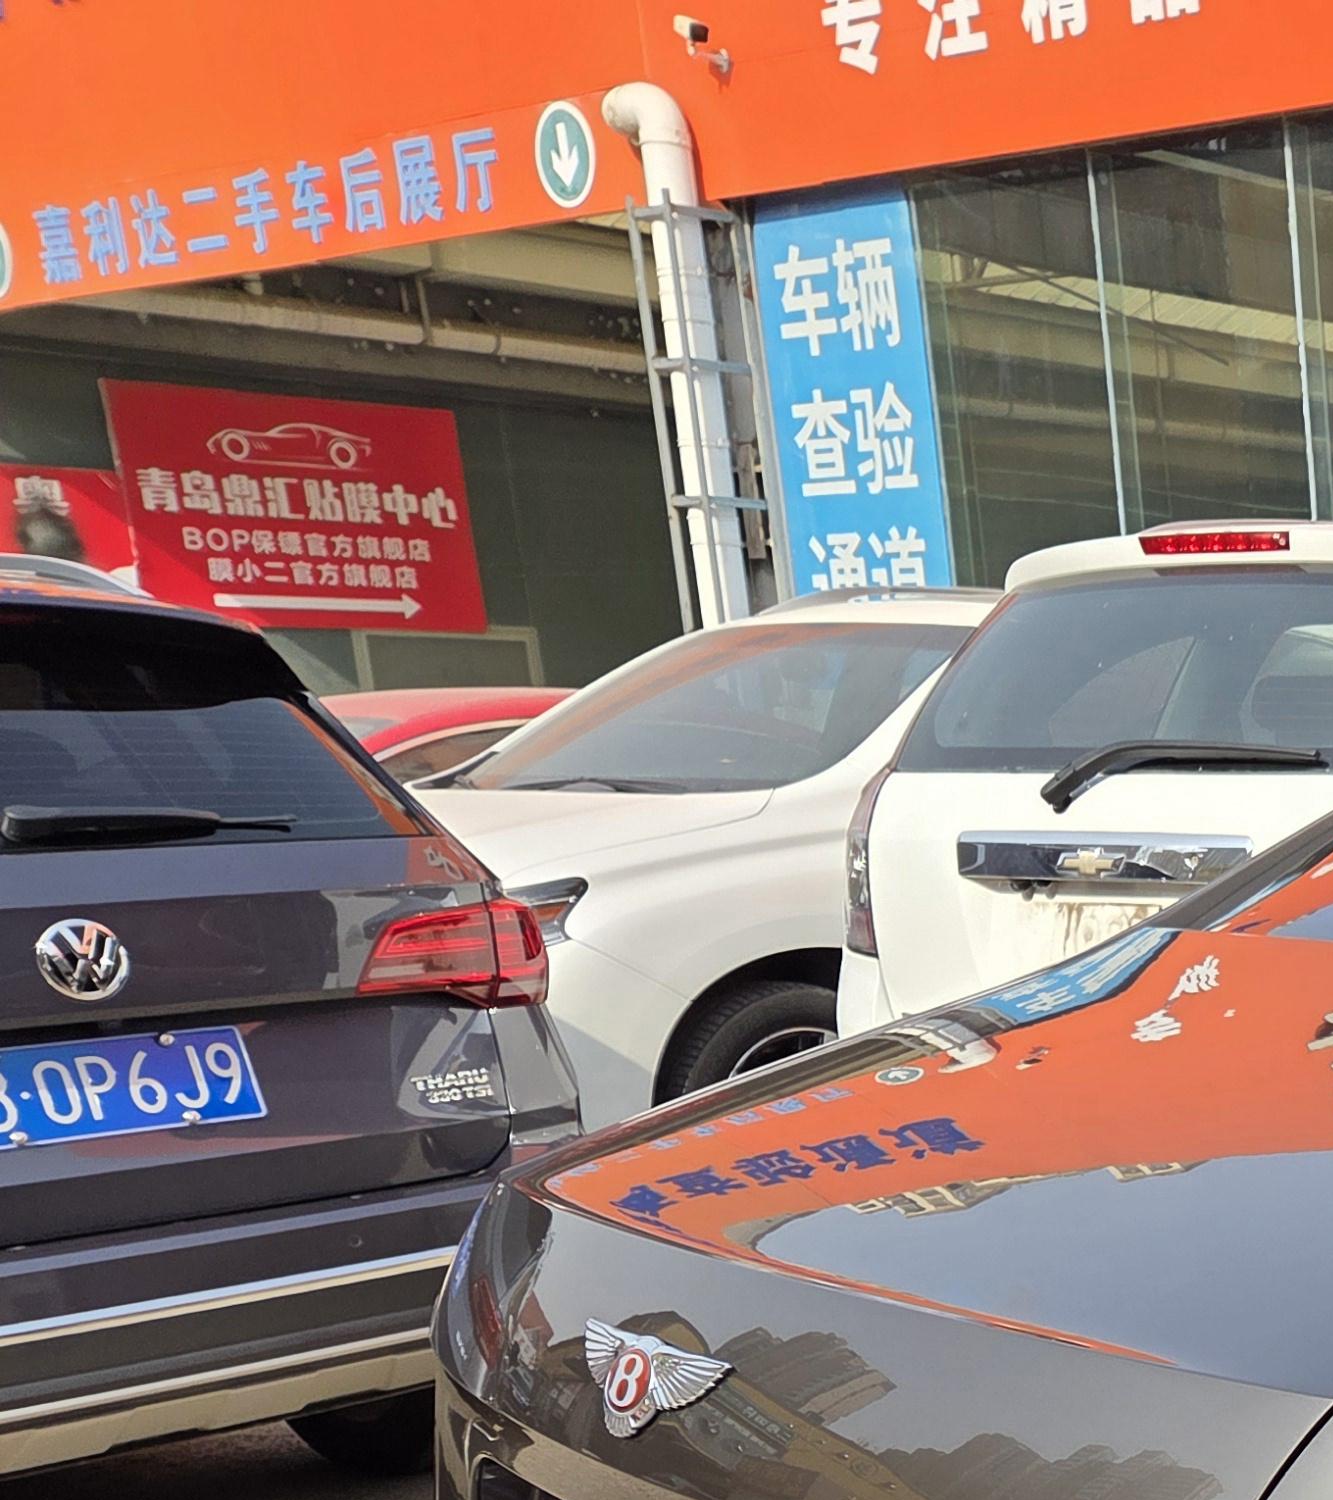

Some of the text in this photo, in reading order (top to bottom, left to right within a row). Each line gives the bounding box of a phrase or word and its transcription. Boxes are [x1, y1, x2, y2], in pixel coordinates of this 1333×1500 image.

[32, 126, 499, 284] 嘉利达二手车后展厅
[774, 237, 900, 356] 车辆
[791, 381, 919, 496] 查验
[136, 467, 458, 529] 青岛鼎汇贴膜中心
[808, 525, 926, 594] 通道
[410, 1067, 489, 1091] THARU
